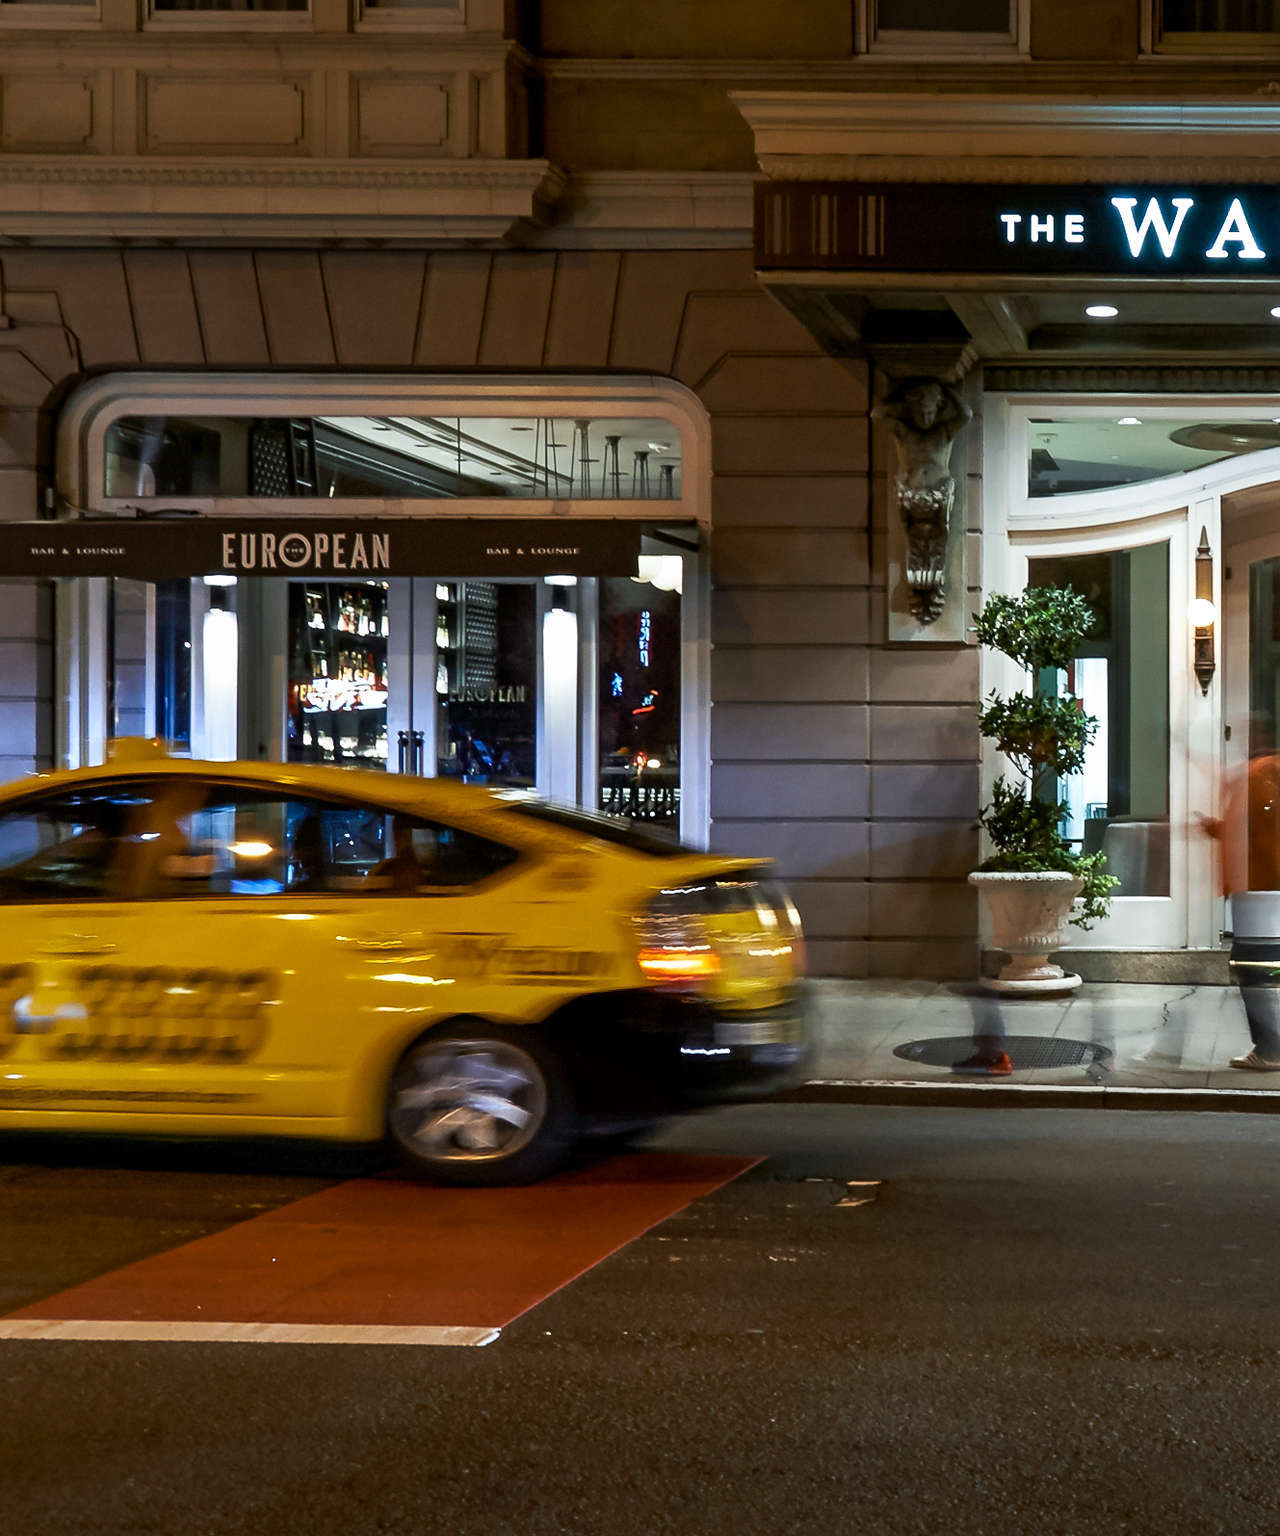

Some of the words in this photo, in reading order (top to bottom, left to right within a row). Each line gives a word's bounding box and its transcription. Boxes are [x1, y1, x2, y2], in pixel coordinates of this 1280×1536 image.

[1000, 214, 1085, 243] THE
[31, 547, 55, 555] BAR
[61, 547, 70, 555] &
[76, 547, 126, 555] LOUNGE
[222, 533, 391, 569] EUROPEAN
[486, 547, 510, 555] BAR
[516, 547, 525, 555] &
[531, 547, 581, 555] LOUNGE
